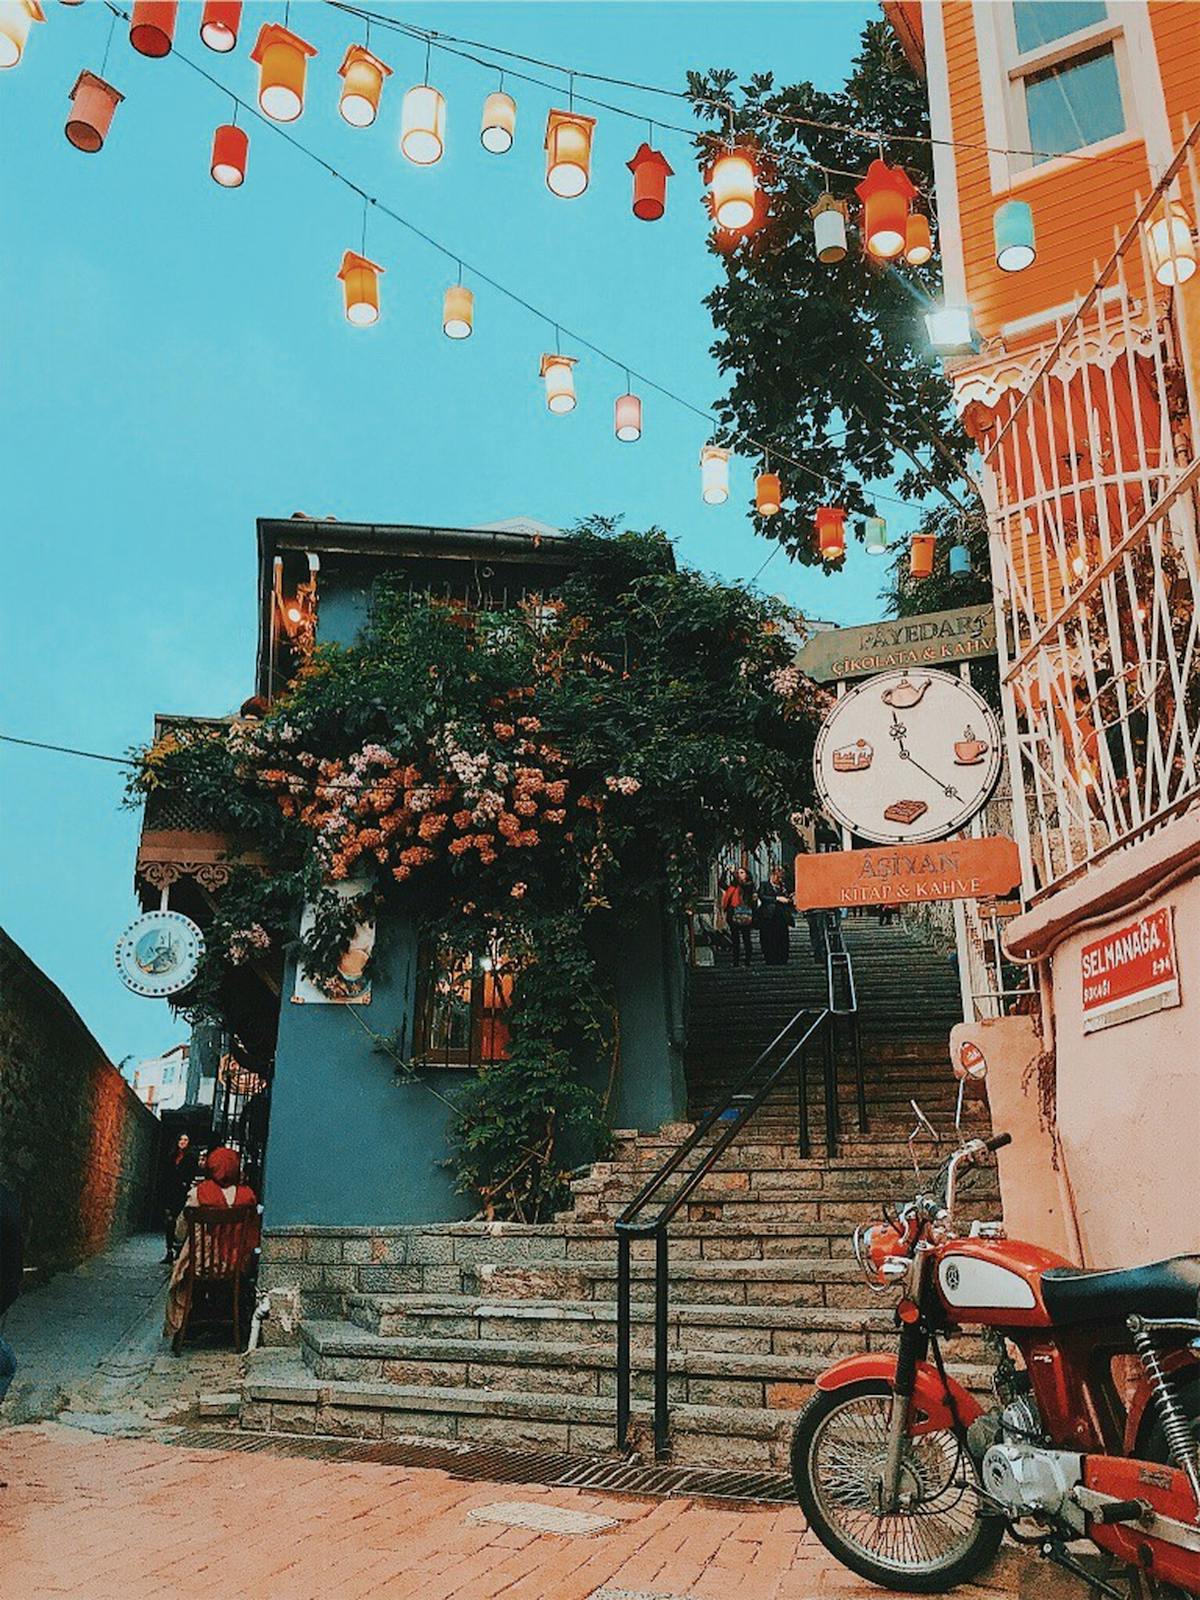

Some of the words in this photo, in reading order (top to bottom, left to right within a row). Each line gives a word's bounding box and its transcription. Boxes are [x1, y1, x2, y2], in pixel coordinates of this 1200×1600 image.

[922, 647, 936, 660] &
[941, 638, 997, 657] KAHV
[896, 884, 911, 898] &
[916, 878, 982, 897] KAHVE
